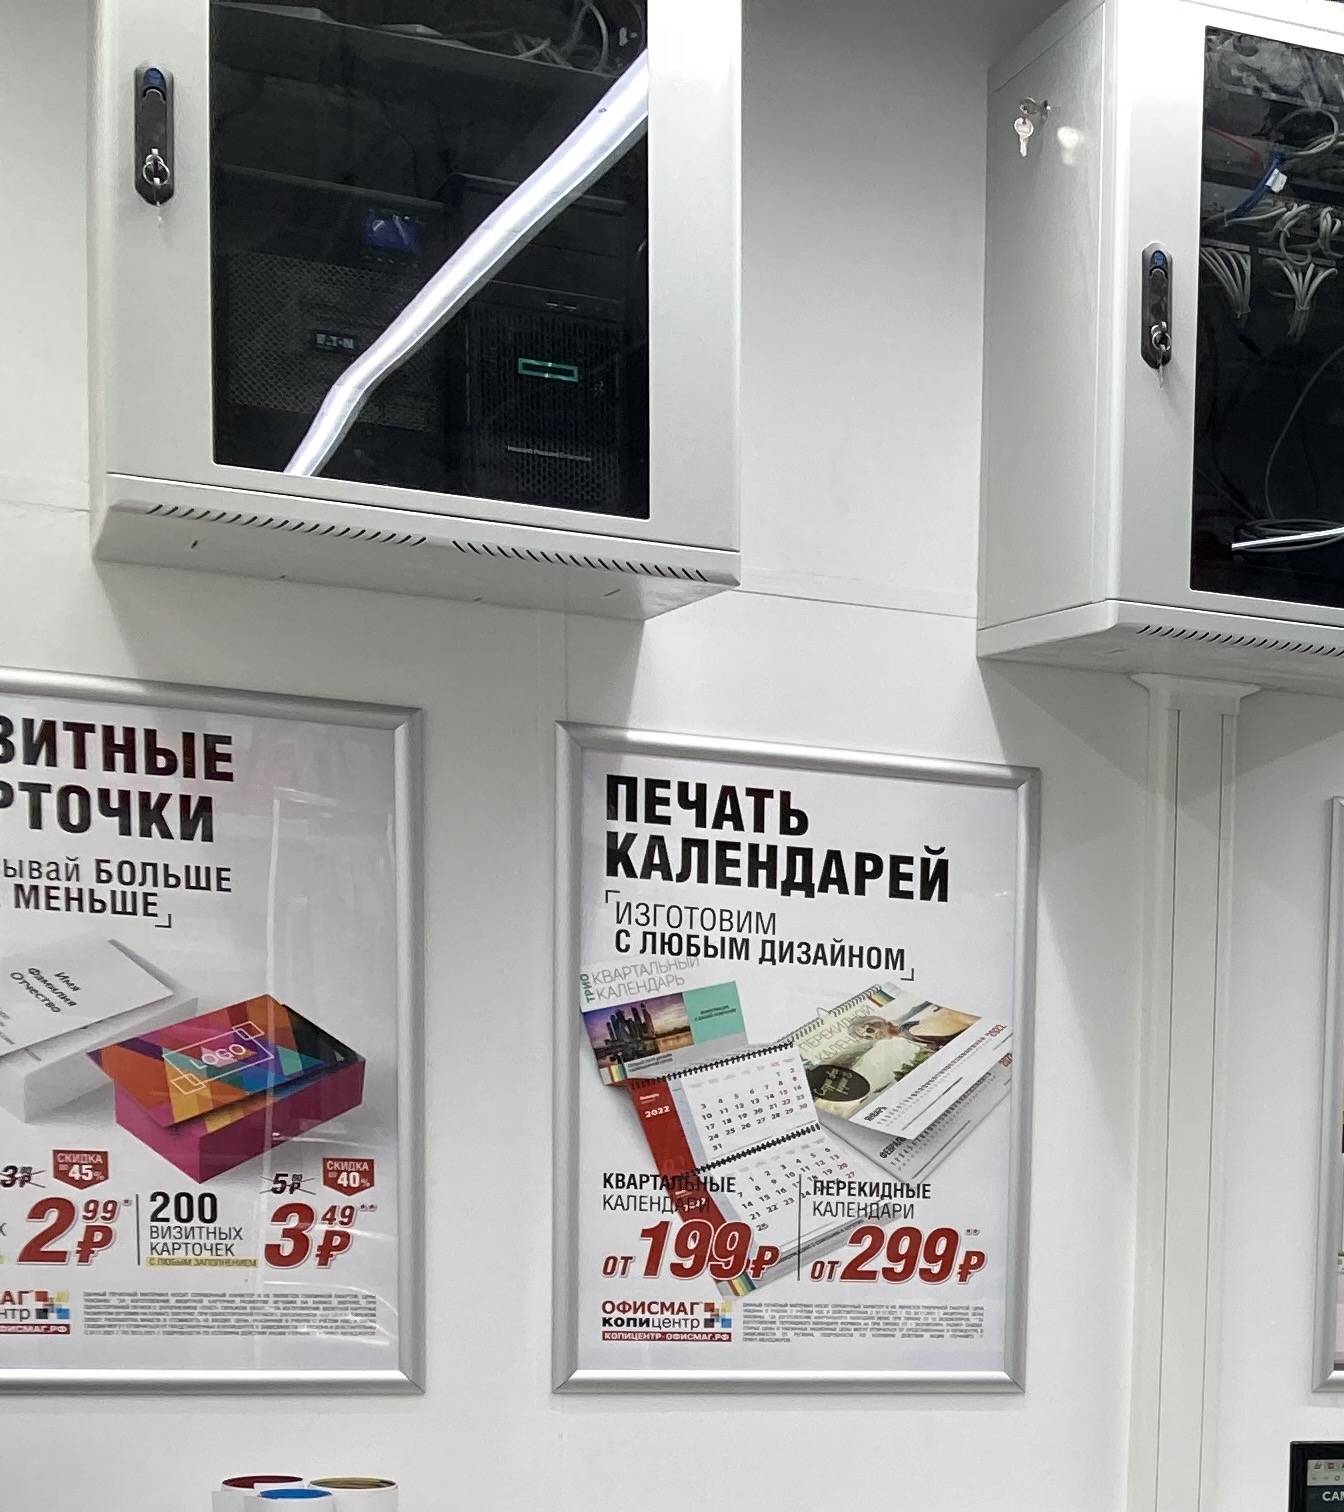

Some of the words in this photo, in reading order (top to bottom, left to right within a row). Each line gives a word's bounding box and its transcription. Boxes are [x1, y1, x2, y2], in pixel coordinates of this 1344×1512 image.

[604, 773, 810, 838] ПЕЧАТЬ
[95, 858, 232, 893] БОЛЬШЕ
[604, 831, 950, 903] КАЛЕНДАРЕЙ
[13, 883, 159, 918] МЕНЬШЕ
[614, 902, 777, 936] ИЗГОТОВИМ
[614, 928, 631, 954] С
[639, 931, 750, 961] ЛЮБЫМ
[758, 938, 908, 972] ДИЗАЙНОМ
[54, 971, 81, 993] Имя
[594, 973, 686, 1000] КАЛЕНДАРЬ
[189, 1043, 247, 1070] LOGO
[644, 1105, 671, 1119] 2022
[57, 1152, 103, 1165] СКИДКА
[327, 1161, 369, 1172] СКИДКА
[602, 1172, 737, 1194] КВАРТАЛЬНЫЕ
[812, 1179, 932, 1201] ПЕРЕКИДНЫЕ
[150, 1191, 218, 1224] 200
[602, 1194, 711, 1215] КАЛЕНДАРИ
[812, 1200, 916, 1221] КАЛЕНДАРИ
[150, 1225, 244, 1241] ВИЗИТНЫХ
[150, 1242, 236, 1257] КАРТОЧЕК
[602, 1301, 700, 1316] ОФИСМАГ
[602, 1316, 701, 1331] копицентр
